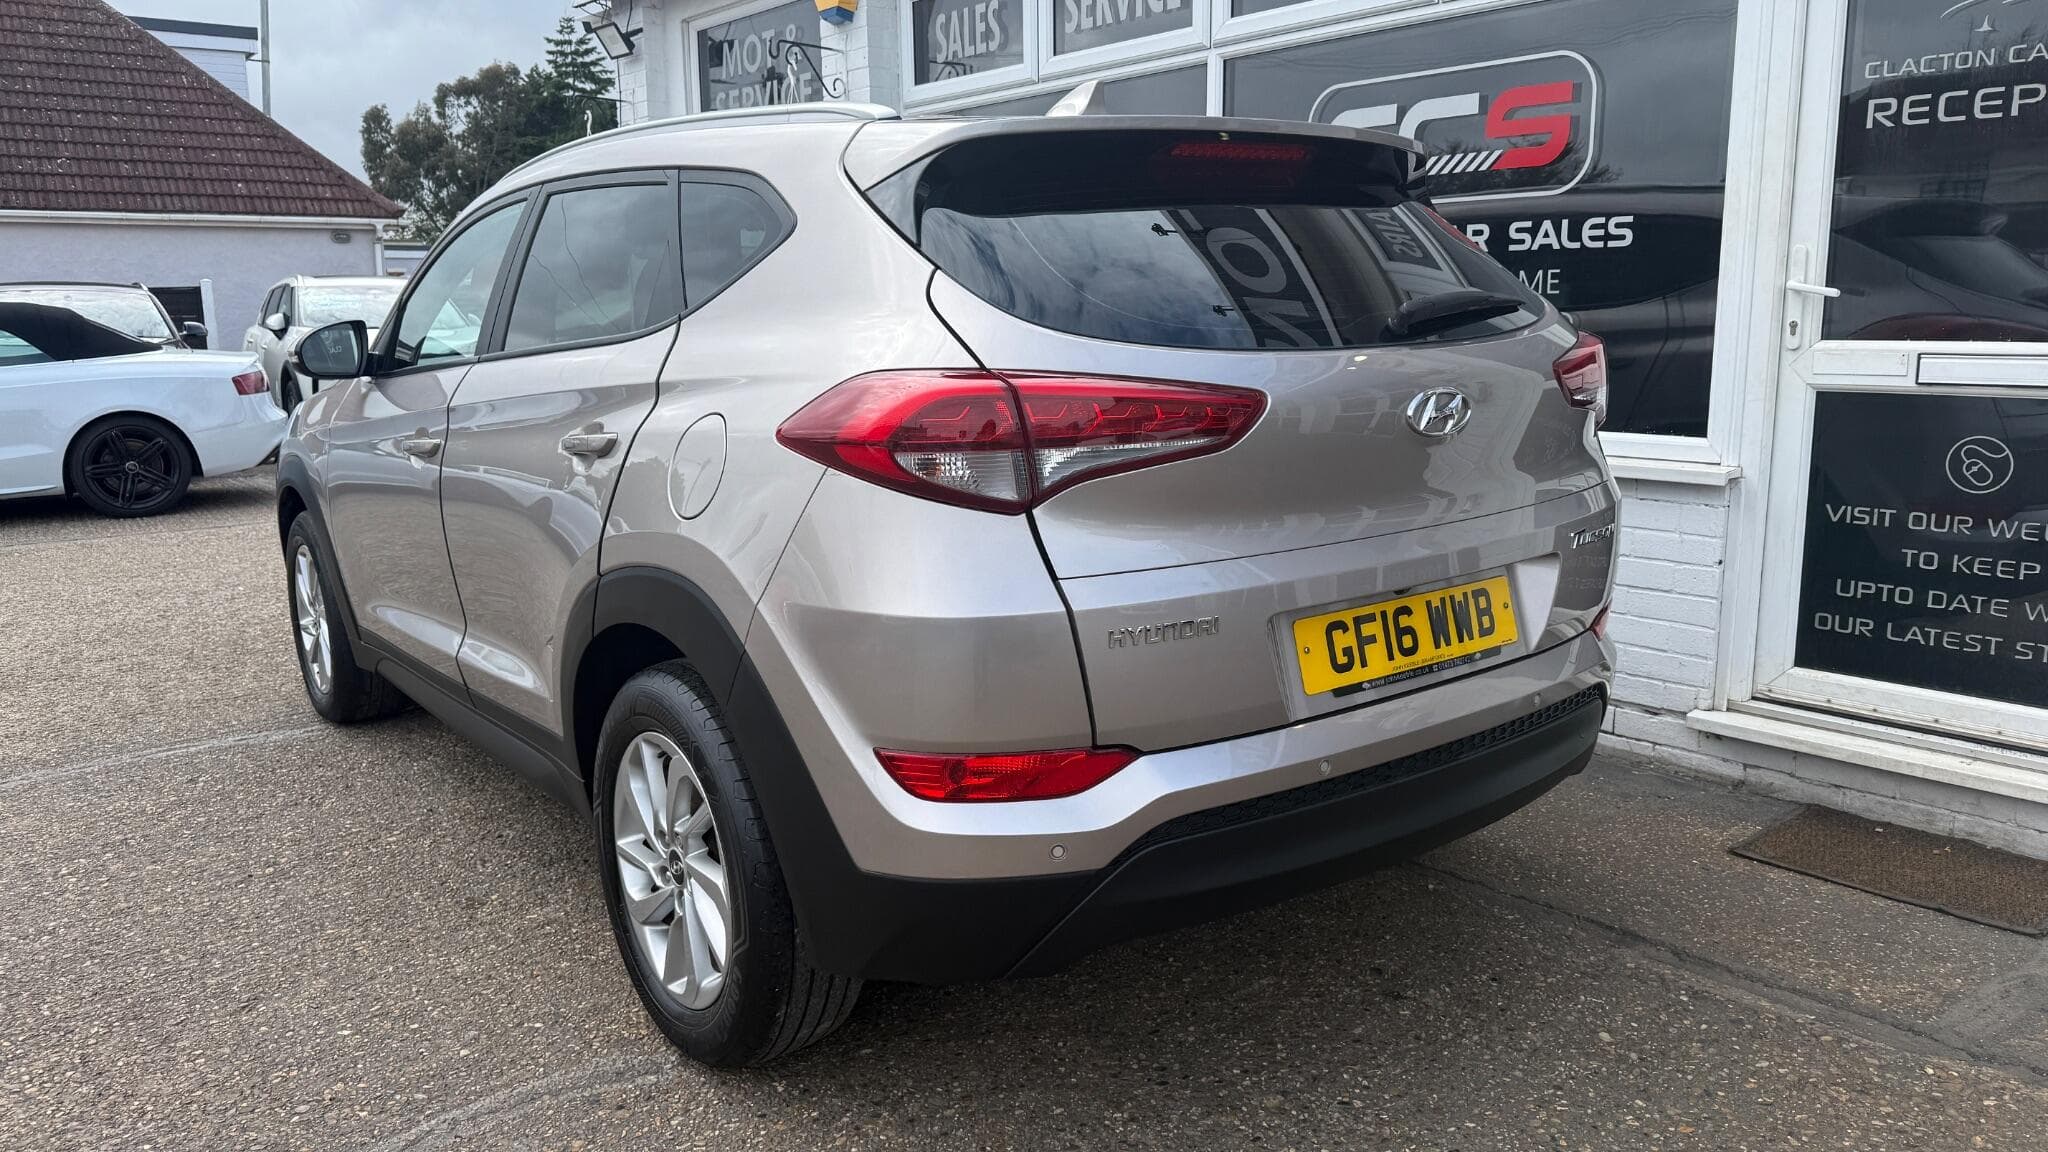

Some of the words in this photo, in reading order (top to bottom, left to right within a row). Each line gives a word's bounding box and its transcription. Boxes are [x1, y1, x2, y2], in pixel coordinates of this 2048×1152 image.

[936, 0, 1000, 63] SALES
[722, 29, 775, 79] MOT
[1864, 48, 1996, 79] CLACTON
[2008, 42, 2048, 63] CA
[1865, 83, 2047, 129] RECEP
[1508, 215, 1634, 251] SALES
[1825, 503, 1897, 528] VISIT
[1908, 511, 1974, 535] OUR
[1988, 518, 2048, 542] WE
[1901, 548, 1939, 570] TO
[1951, 554, 2041, 581] KEEP
[1835, 578, 1914, 605] UPTO
[1927, 590, 2010, 618] DATE
[1107, 615, 1219, 649] HYUNDAI
[1325, 605, 1419, 674] GF16
[1426, 587, 1496, 650] WWB
[1814, 612, 1874, 637] OUR
[1886, 622, 2003, 656] LATEST
